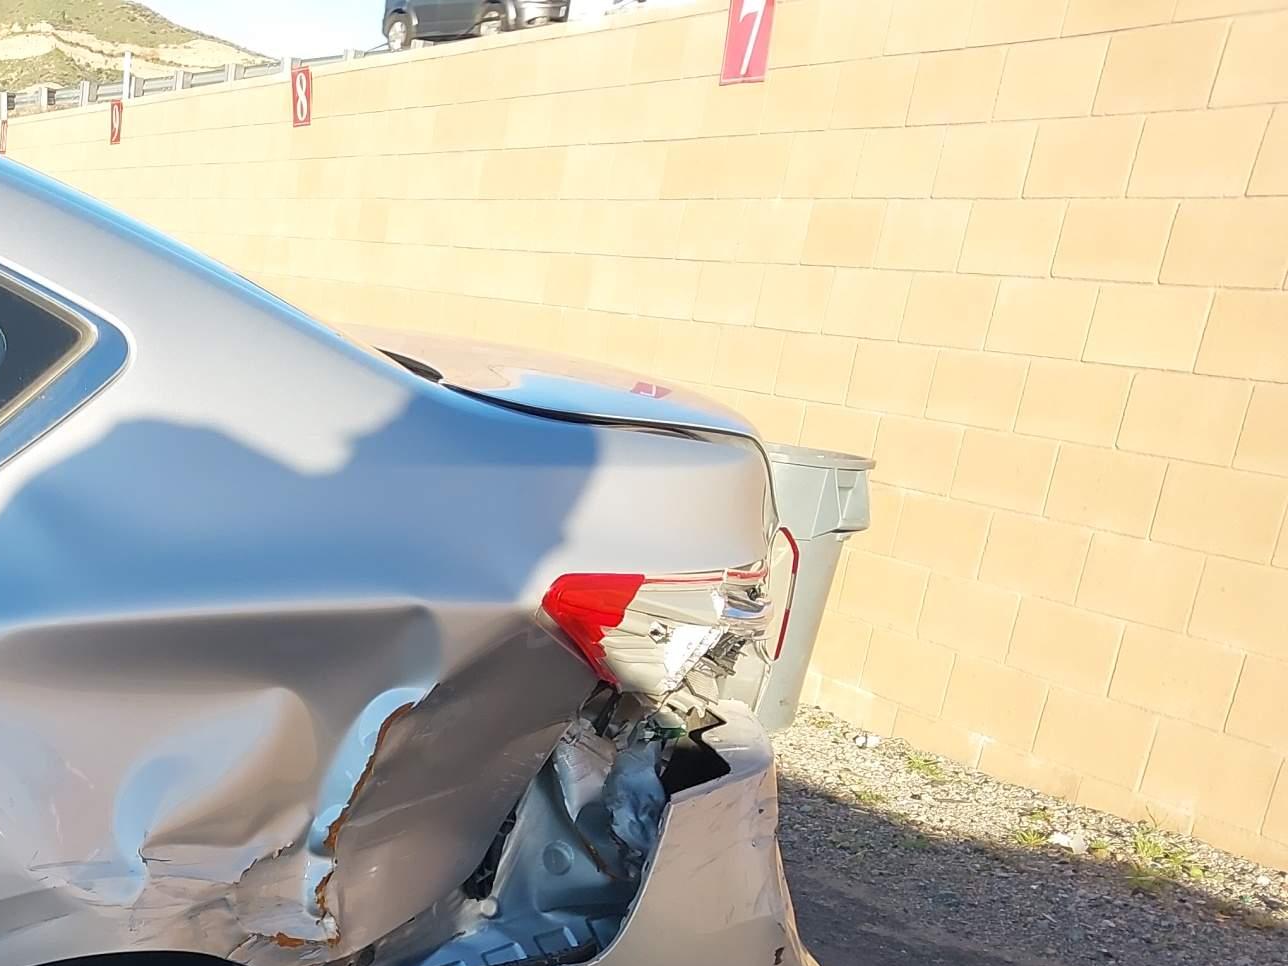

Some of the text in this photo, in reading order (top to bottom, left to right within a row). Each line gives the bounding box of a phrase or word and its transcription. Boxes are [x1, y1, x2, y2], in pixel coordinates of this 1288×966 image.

[739, 0, 767, 76] 7
[295, 72, 308, 122] 8
[112, 104, 120, 142] 9
